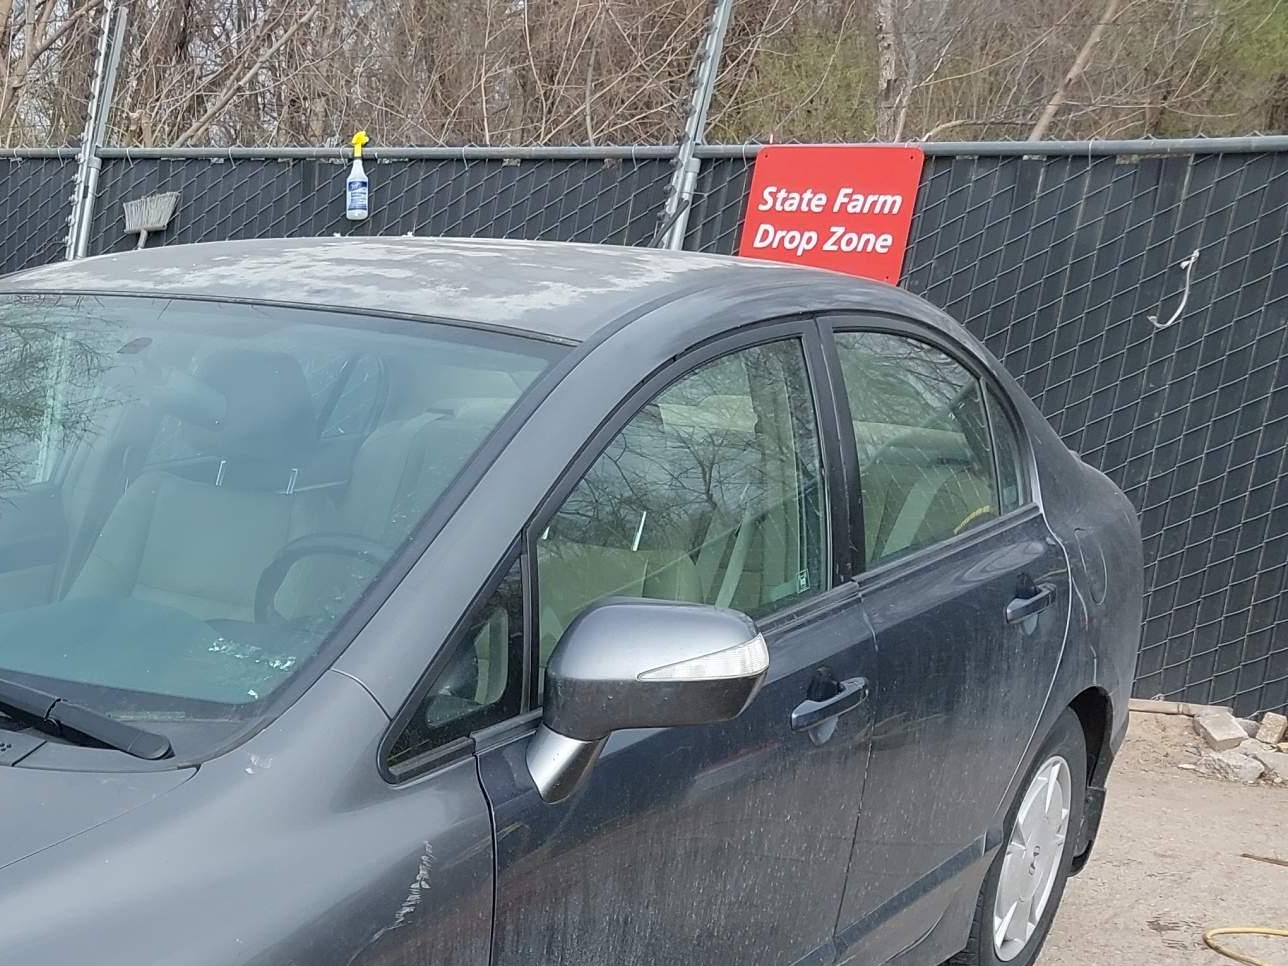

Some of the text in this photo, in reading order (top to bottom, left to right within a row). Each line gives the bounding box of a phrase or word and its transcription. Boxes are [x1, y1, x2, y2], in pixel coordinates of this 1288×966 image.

[758, 185, 903, 215] State Farm
[752, 223, 893, 256] Drop Zone
